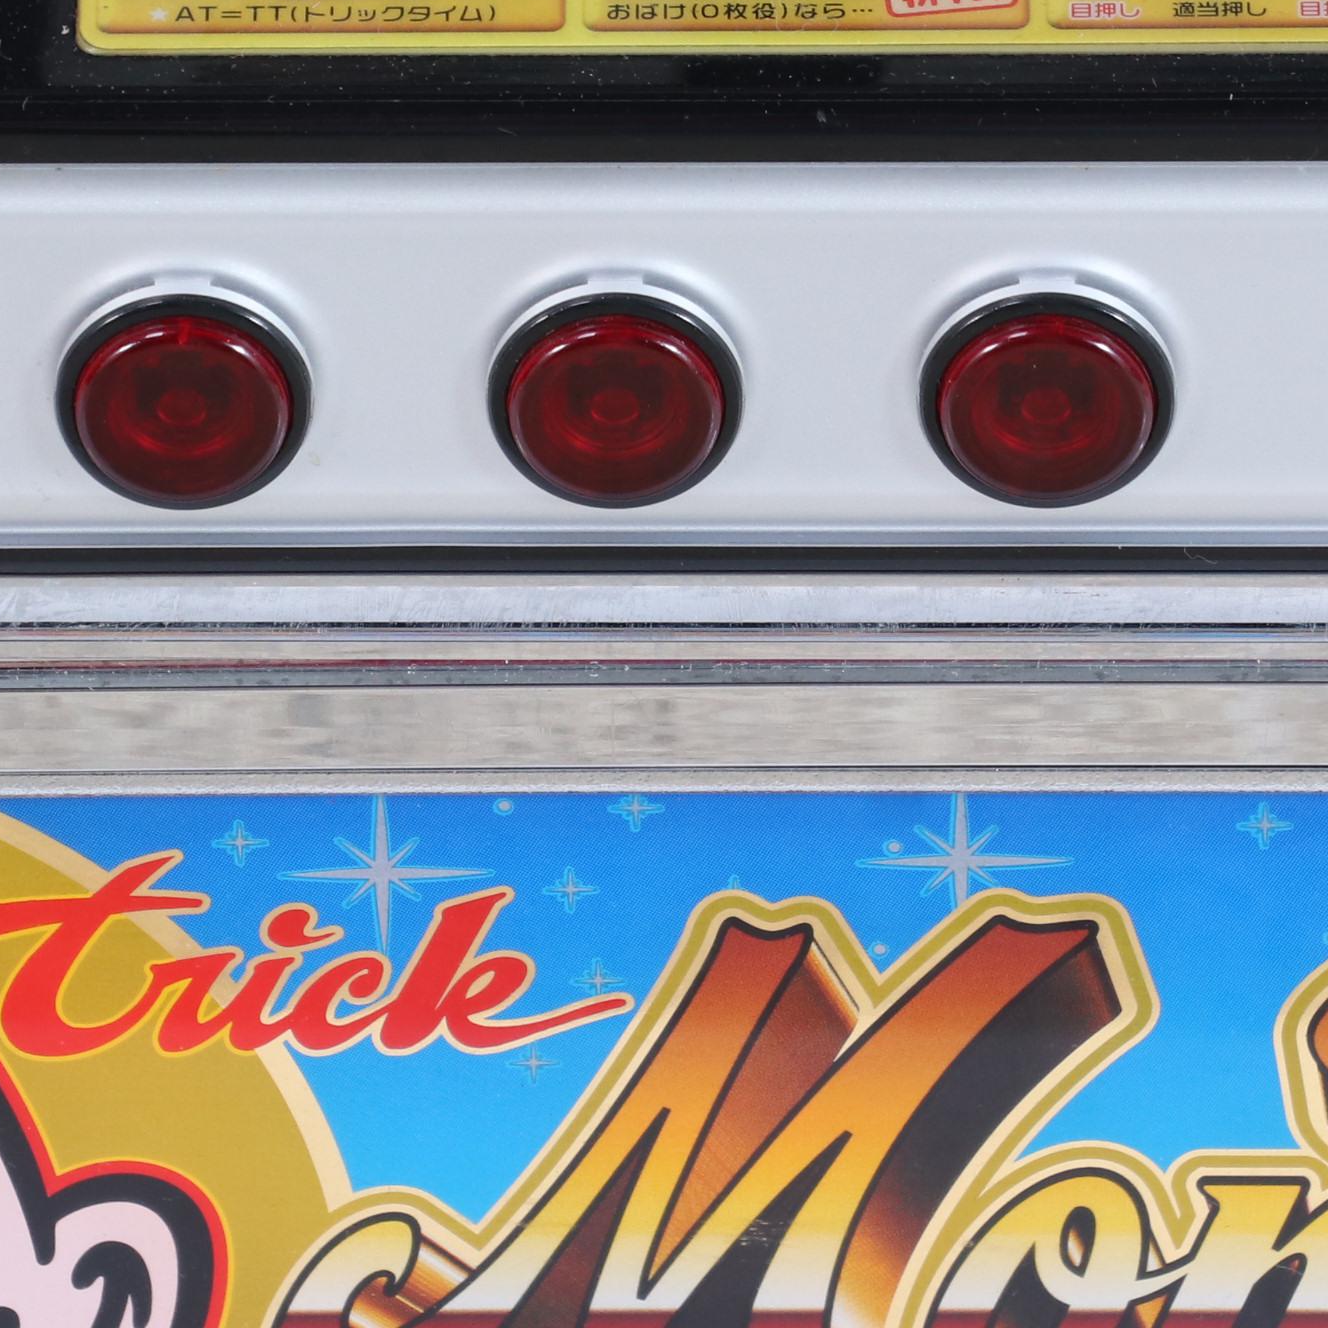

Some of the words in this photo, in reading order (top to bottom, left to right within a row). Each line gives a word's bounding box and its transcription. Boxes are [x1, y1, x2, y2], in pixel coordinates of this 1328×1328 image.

[1071, 2, 1141, 19] 目押し
[1172, 0, 1268, 18] 適当押し
